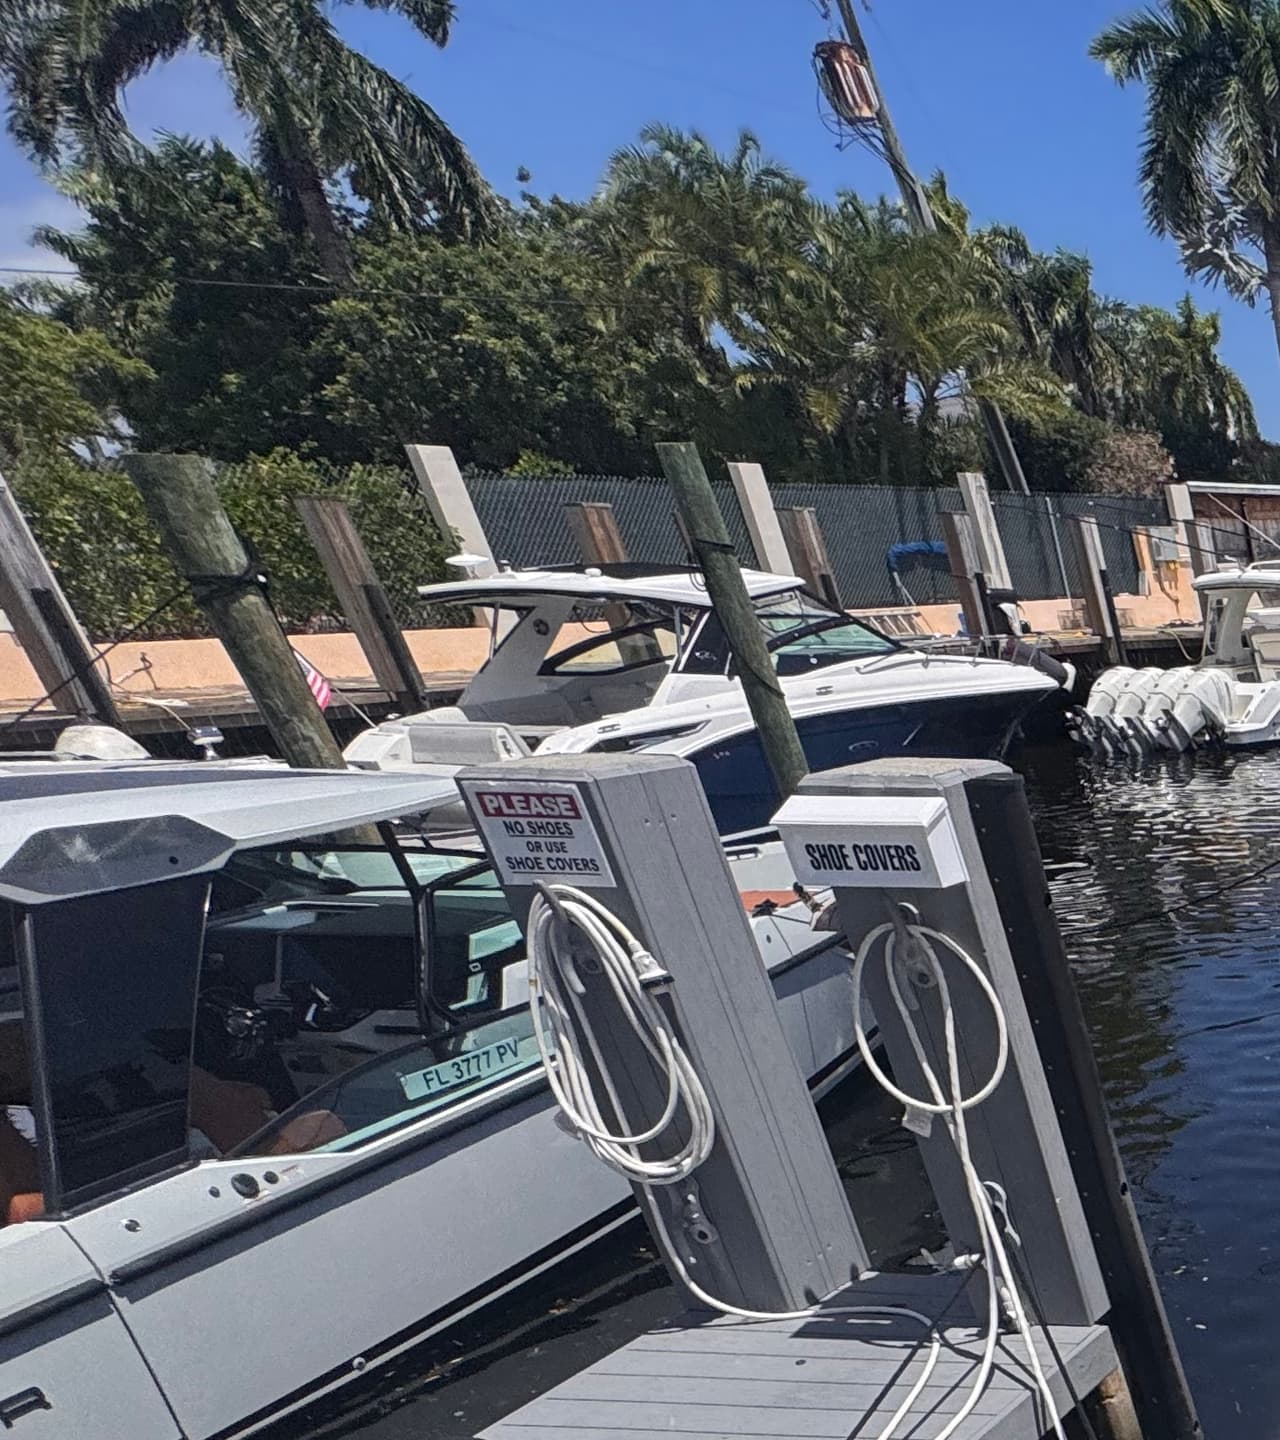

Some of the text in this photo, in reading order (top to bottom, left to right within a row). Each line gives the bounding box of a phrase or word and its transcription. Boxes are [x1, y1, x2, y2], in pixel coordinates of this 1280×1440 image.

[481, 794, 576, 817] PLEASE
[502, 820, 574, 836] NO SHOES
[525, 841, 569, 854] OR USE
[505, 856, 601, 872] SHOE COVERS
[804, 843, 922, 872] SHOE COVERS
[422, 1039, 519, 1090] FL 3777 PV
